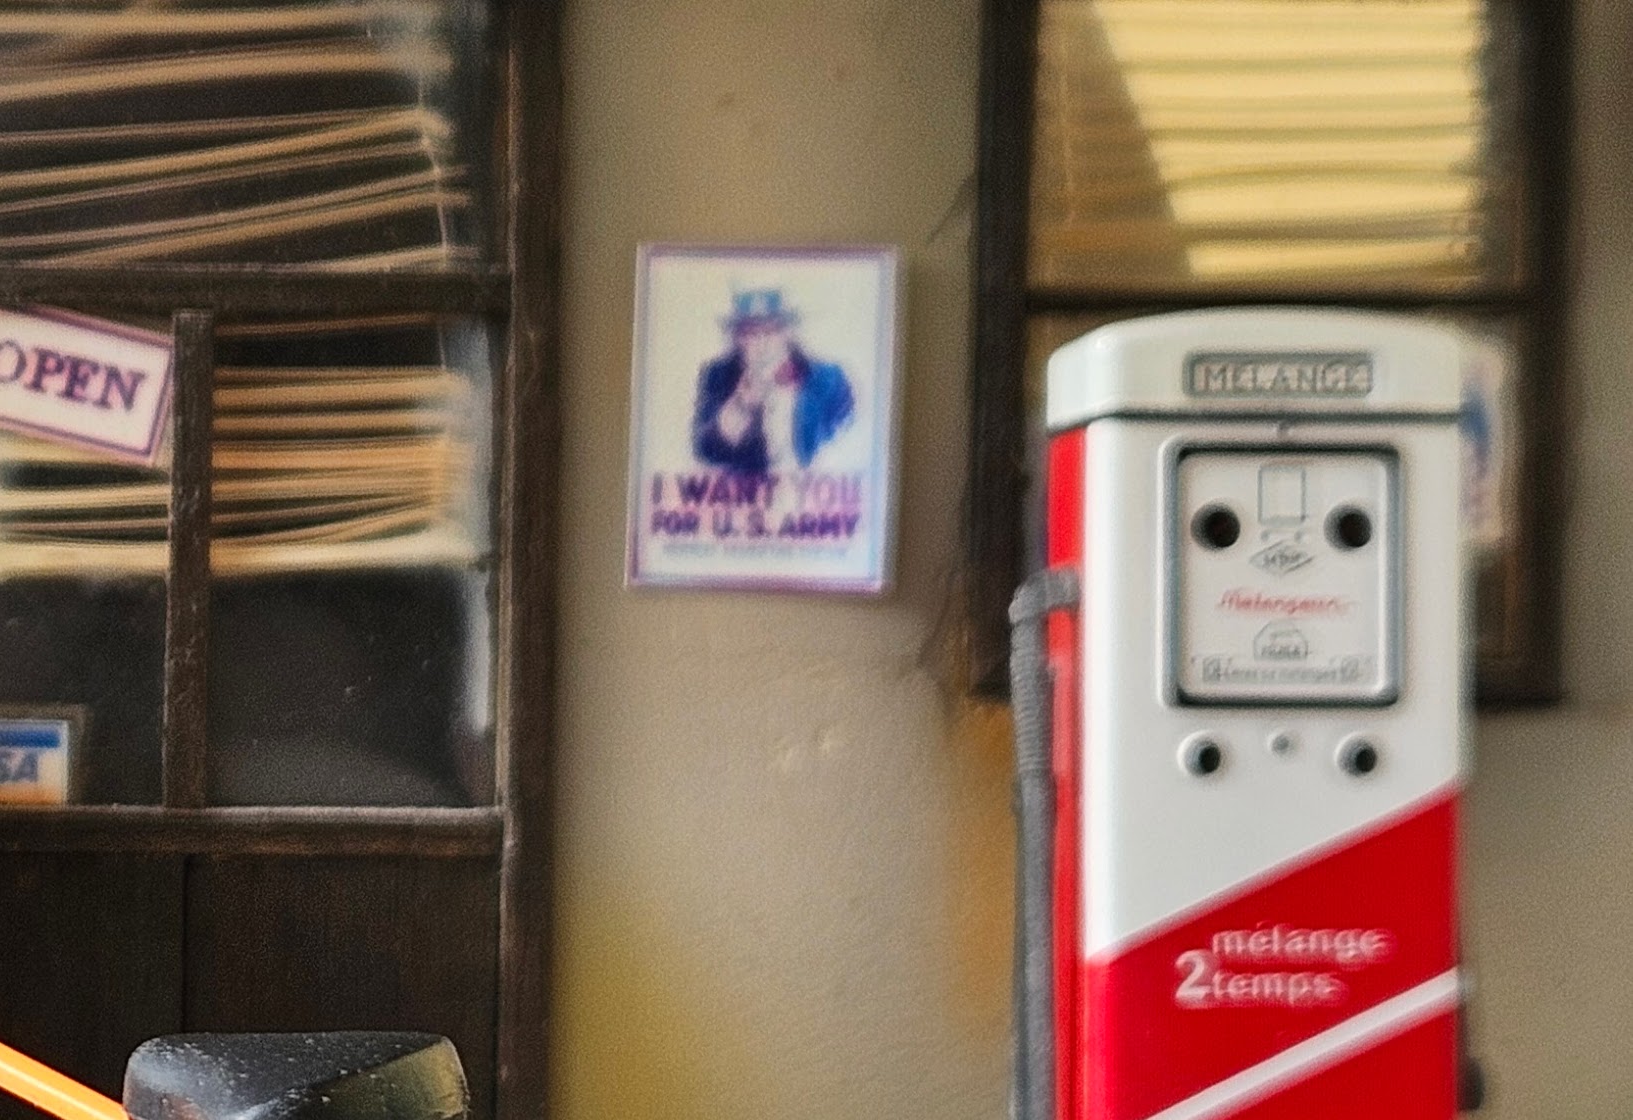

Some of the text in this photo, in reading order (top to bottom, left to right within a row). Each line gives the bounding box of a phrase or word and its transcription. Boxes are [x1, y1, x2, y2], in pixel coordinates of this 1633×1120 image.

[651, 472, 664, 505] I
[676, 472, 779, 506] WANT
[650, 510, 700, 536] FOR
[777, 512, 861, 539] ARMY
[1212, 920, 1392, 965] mélange
[1174, 949, 1339, 1006] 2 temps
